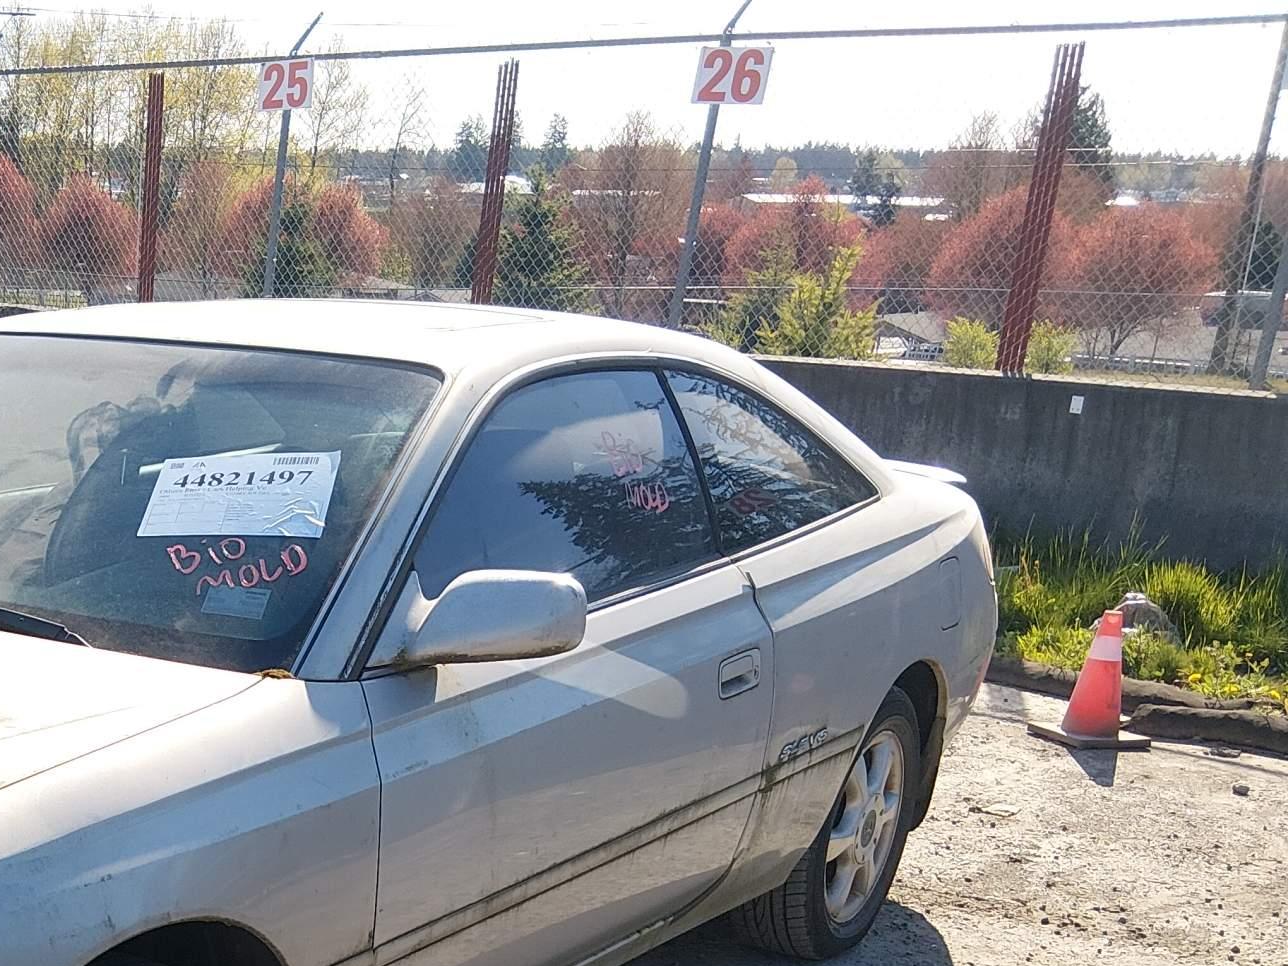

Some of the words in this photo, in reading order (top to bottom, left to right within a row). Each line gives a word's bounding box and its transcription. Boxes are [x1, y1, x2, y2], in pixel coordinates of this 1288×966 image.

[262, 61, 308, 110] 25
[696, 48, 765, 103] 26
[173, 470, 314, 488] 44821497
[196, 543, 309, 596] MOLD
